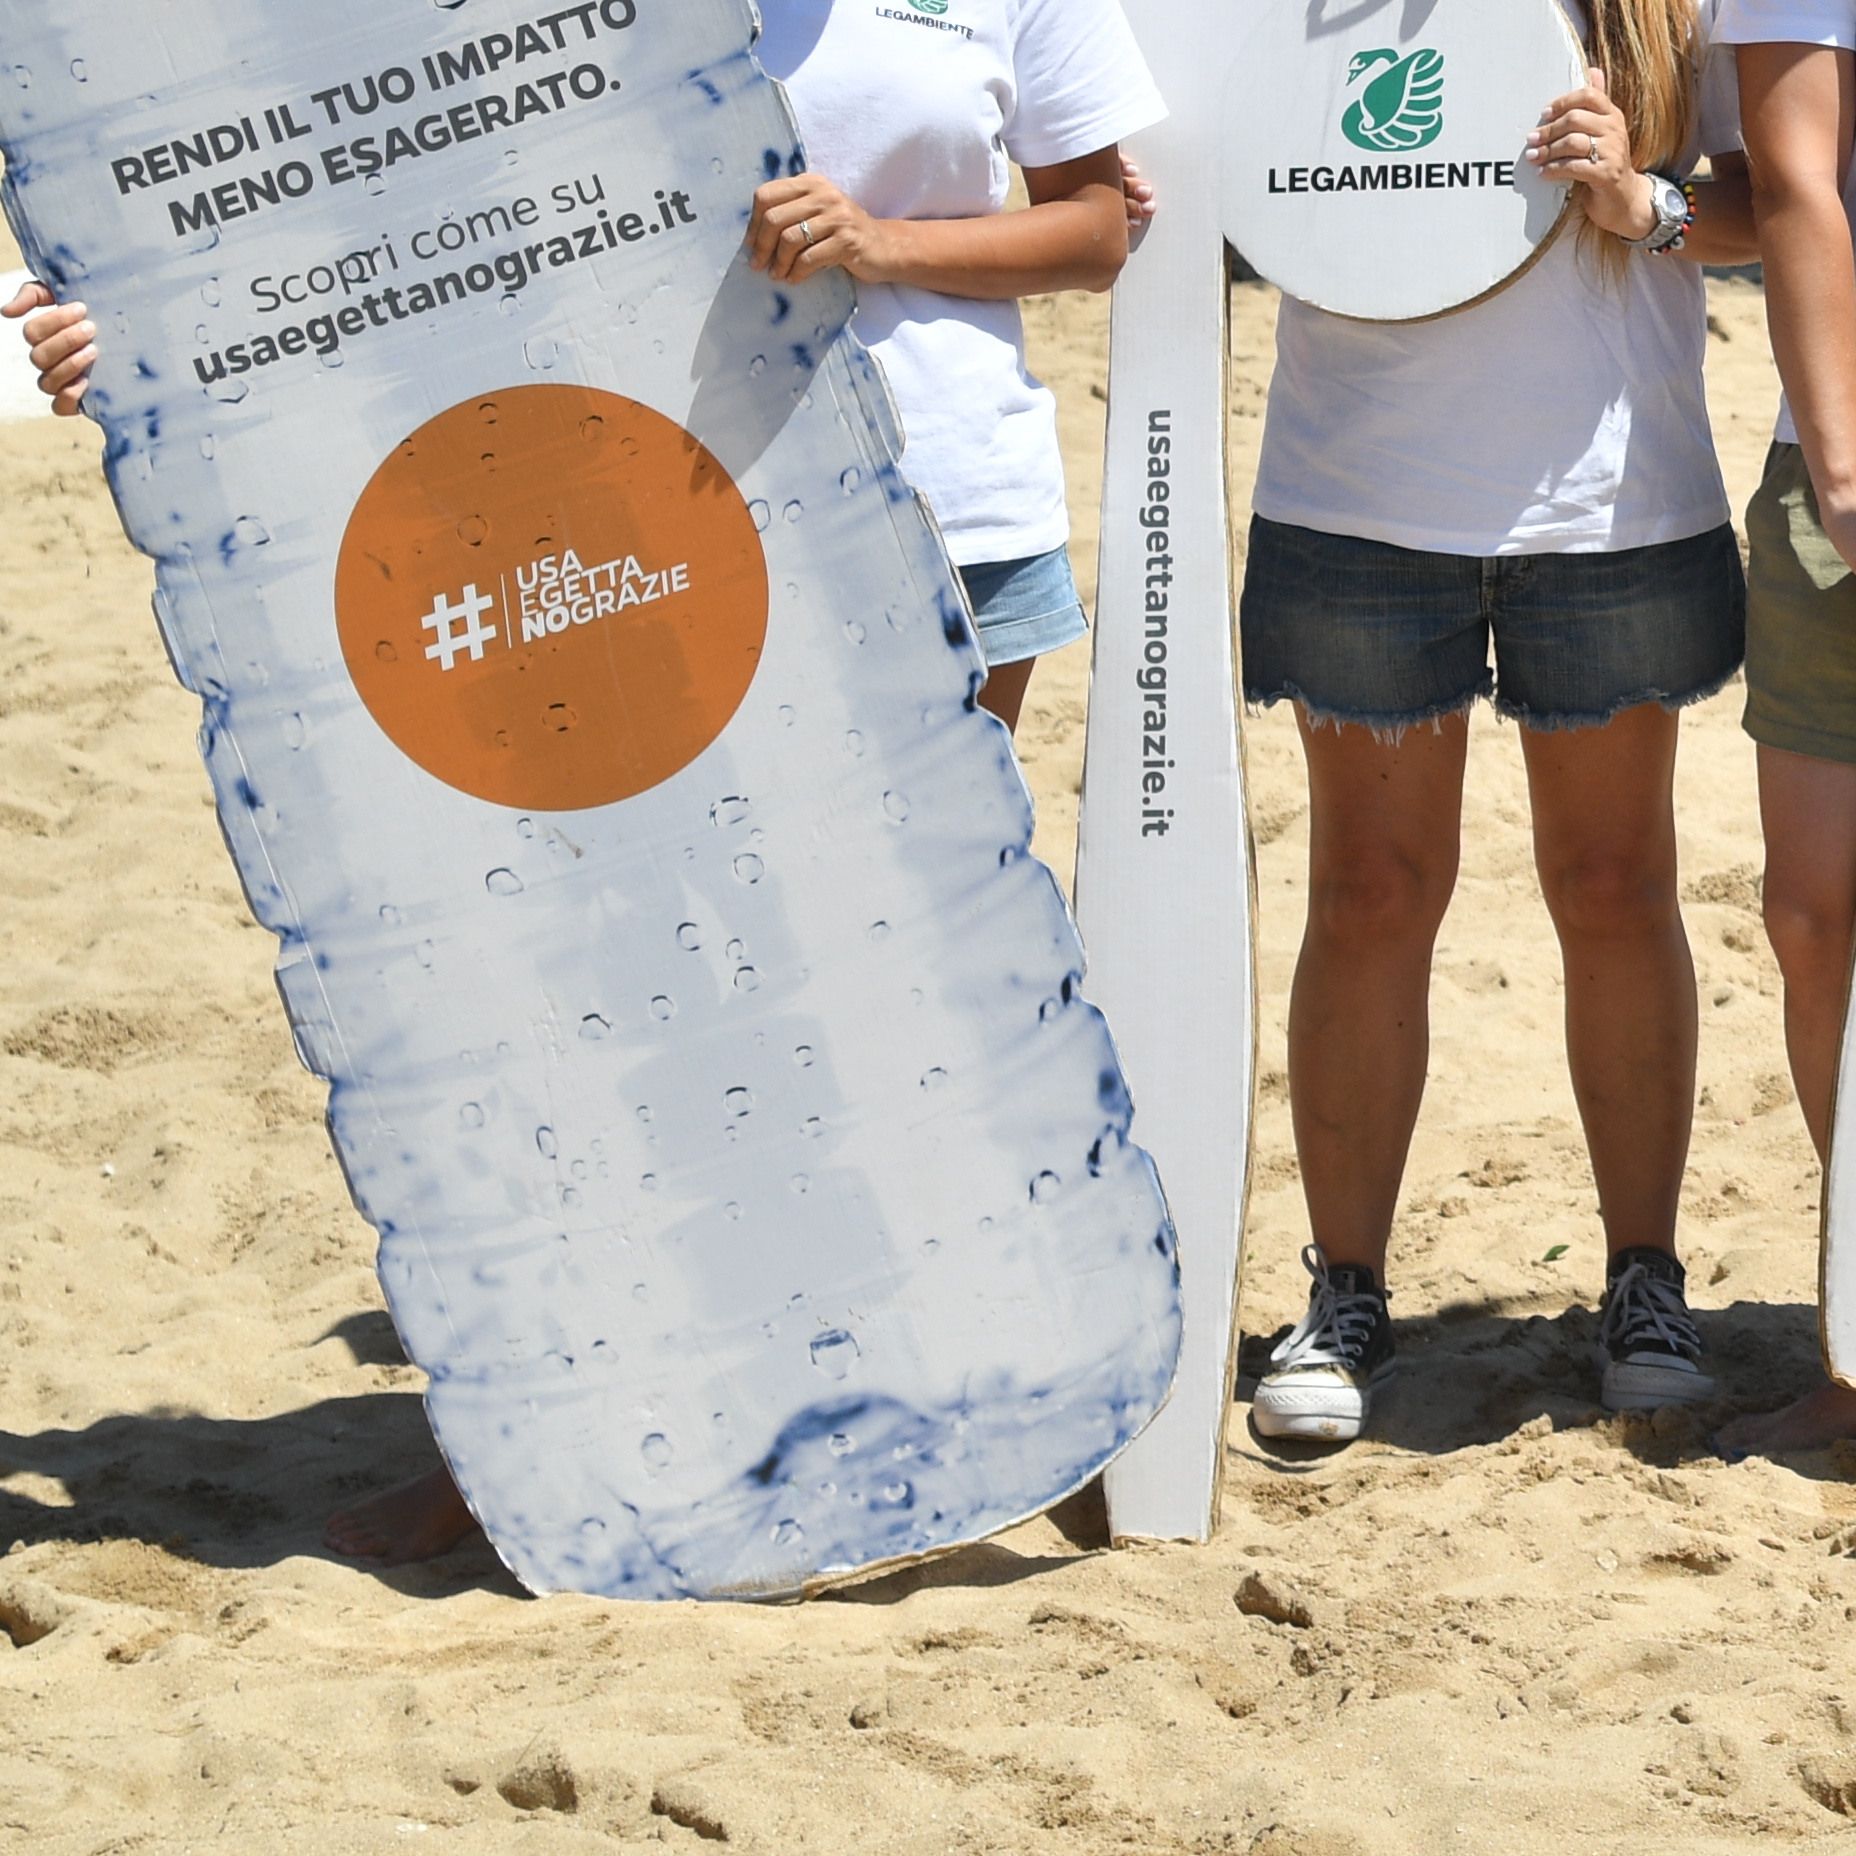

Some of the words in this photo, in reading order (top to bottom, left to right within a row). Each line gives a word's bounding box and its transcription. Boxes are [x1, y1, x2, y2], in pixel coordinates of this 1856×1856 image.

[875, 6, 974, 40] LEGAMBIENTE
[110, 116, 260, 195] RENDI
[265, 103, 313, 148] IL
[310, 65, 415, 127] TUO
[167, 161, 314, 237] MENO
[319, 61, 622, 187] ESAGERATO.
[1268, 160, 1515, 194] LEGAMBIENTE
[193, 187, 698, 385] usaegettanograzie.it
[249, 233, 399, 313] Scopri
[410, 196, 540, 261] come
[551, 172, 606, 215] su
[516, 549, 584, 591] USA
[1136, 409, 1175, 838] usaegettanograzie.it
